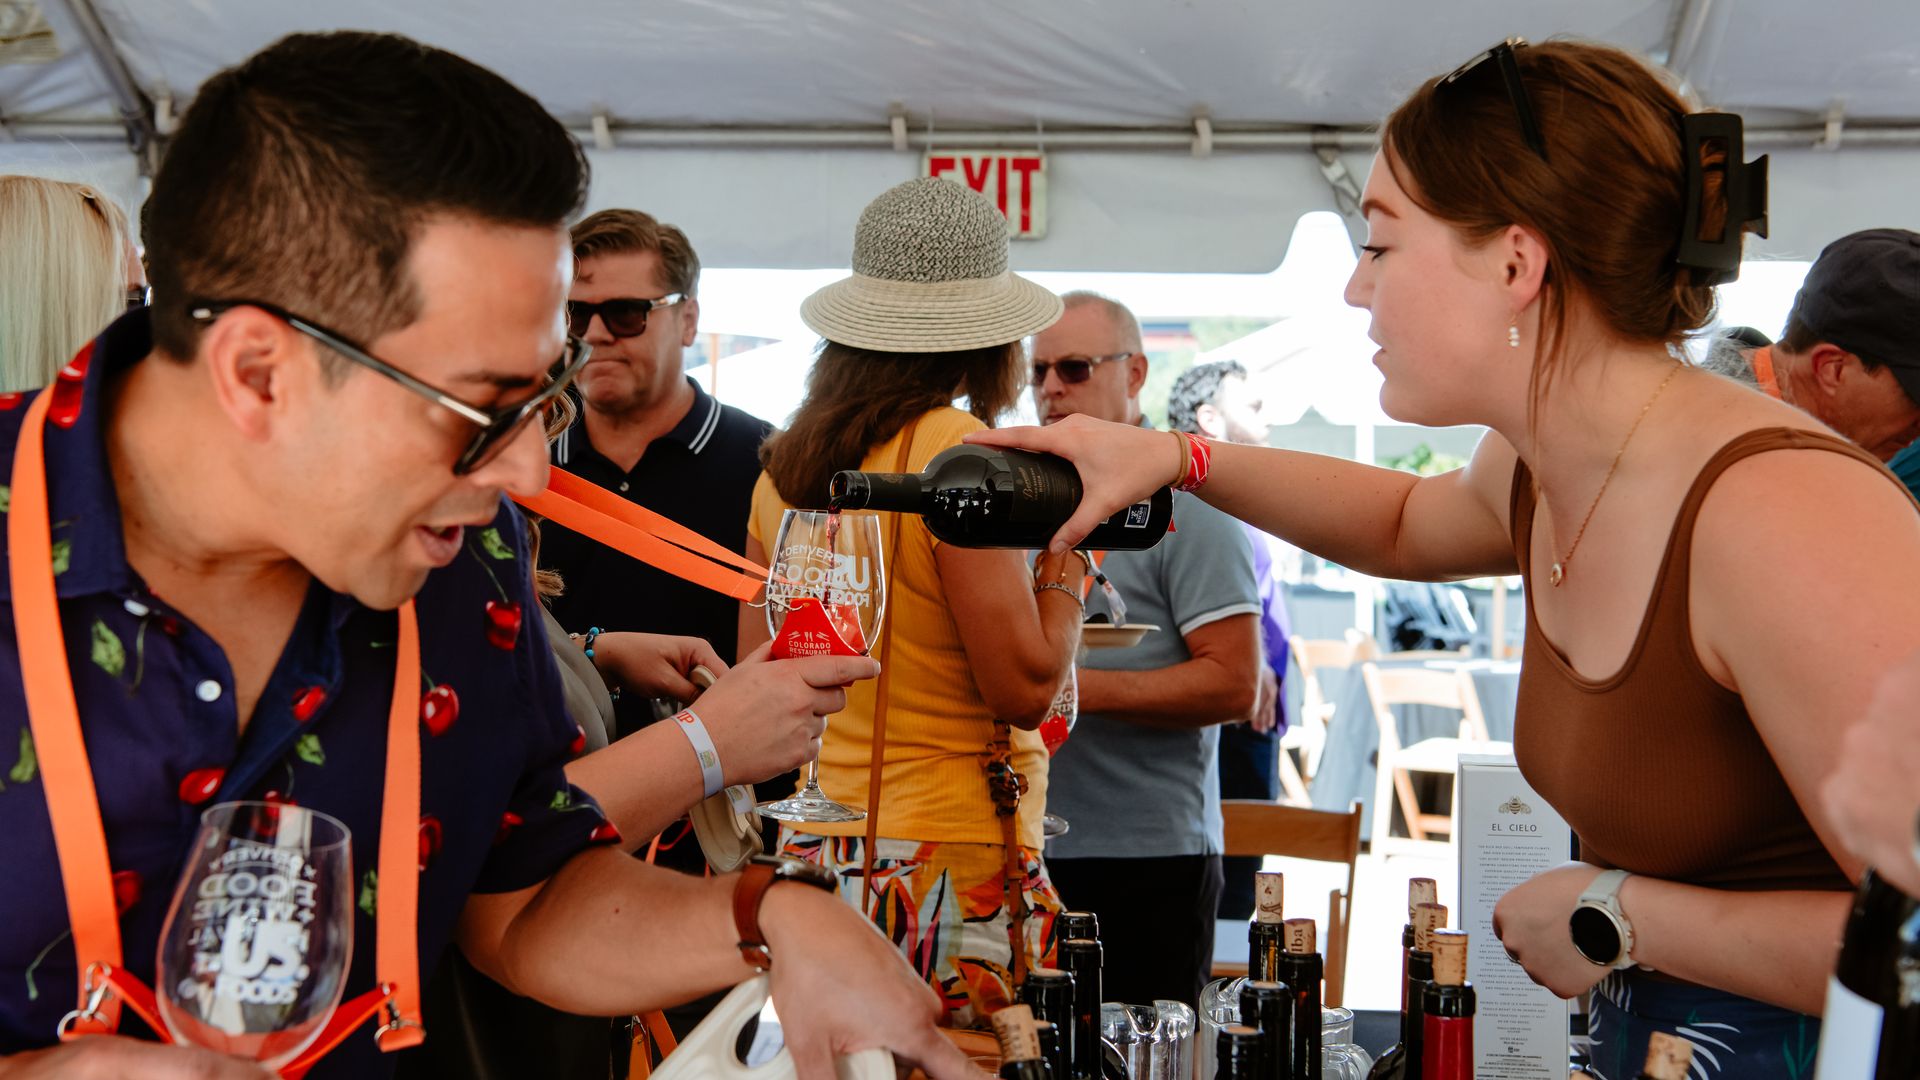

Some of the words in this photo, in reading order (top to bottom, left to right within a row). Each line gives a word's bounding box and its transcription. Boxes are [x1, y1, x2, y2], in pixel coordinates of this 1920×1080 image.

[929, 156, 1042, 233] IT
[785, 545, 834, 561] DENVER
[788, 640, 831, 650] COLORADO
[789, 646, 831, 656] RESTAURANT
[676, 710, 694, 723] IP
[1491, 823, 1502, 832] EL
[1509, 823, 1537, 833] CIELO
